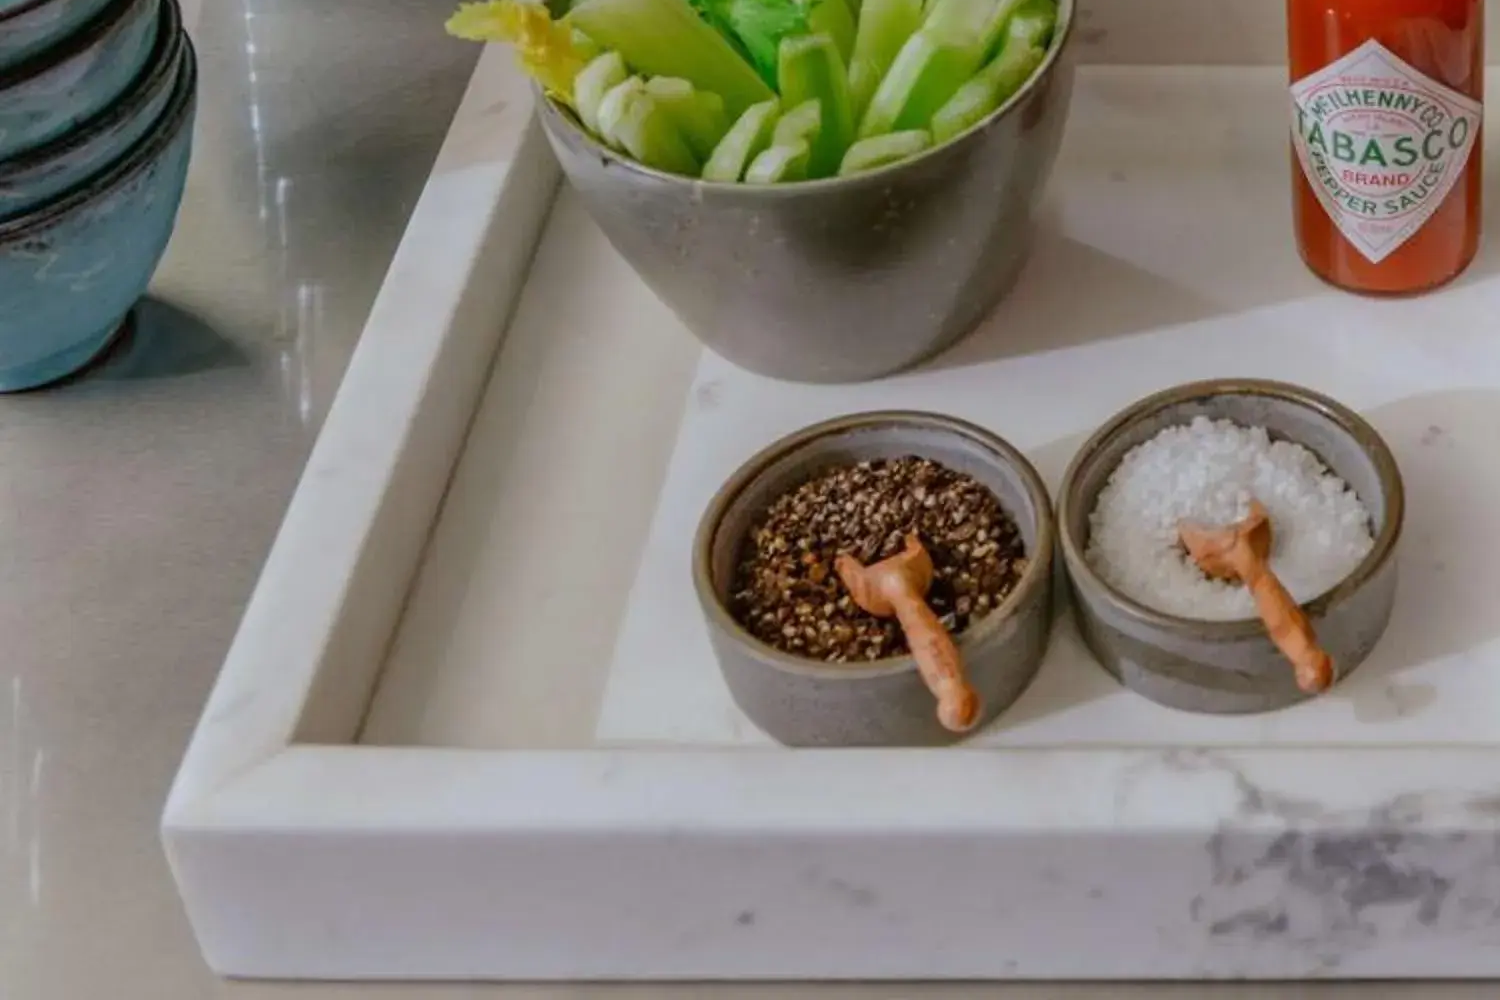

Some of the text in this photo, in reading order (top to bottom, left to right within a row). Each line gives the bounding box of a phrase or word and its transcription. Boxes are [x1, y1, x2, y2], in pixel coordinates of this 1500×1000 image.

[1293, 102, 1469, 168] TABASCO
[1312, 151, 1446, 216] PEPPER SAUCE
[1343, 169, 1411, 187] BRAND
